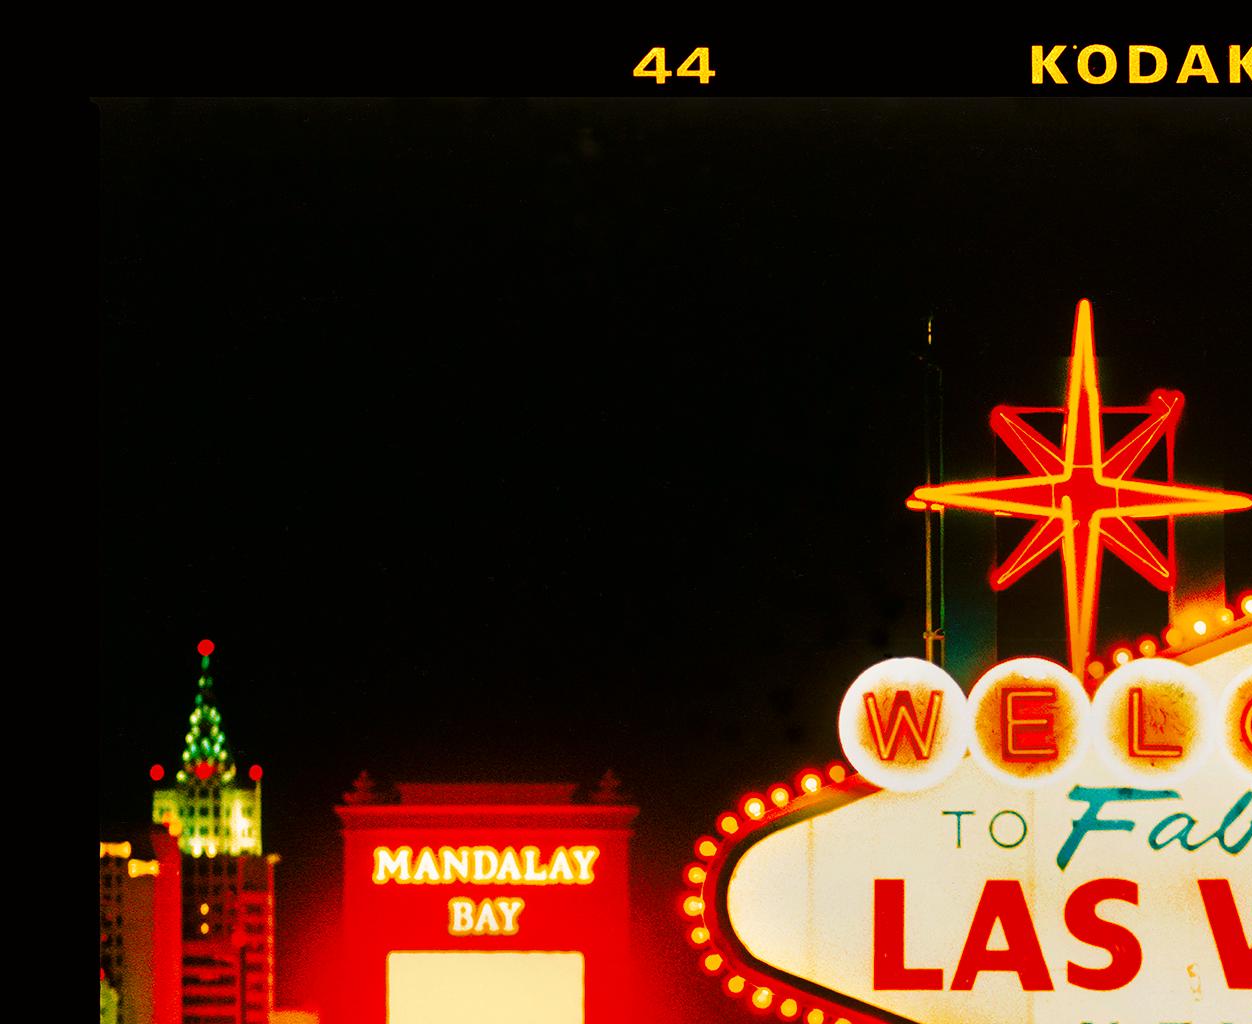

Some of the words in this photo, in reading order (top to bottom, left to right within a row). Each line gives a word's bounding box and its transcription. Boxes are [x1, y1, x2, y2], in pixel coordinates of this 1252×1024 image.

[942, 810, 1028, 849] TO
[374, 847, 599, 884] MANDALAY
[450, 898, 523, 934] BAY
[873, 878, 1143, 992] LAS
